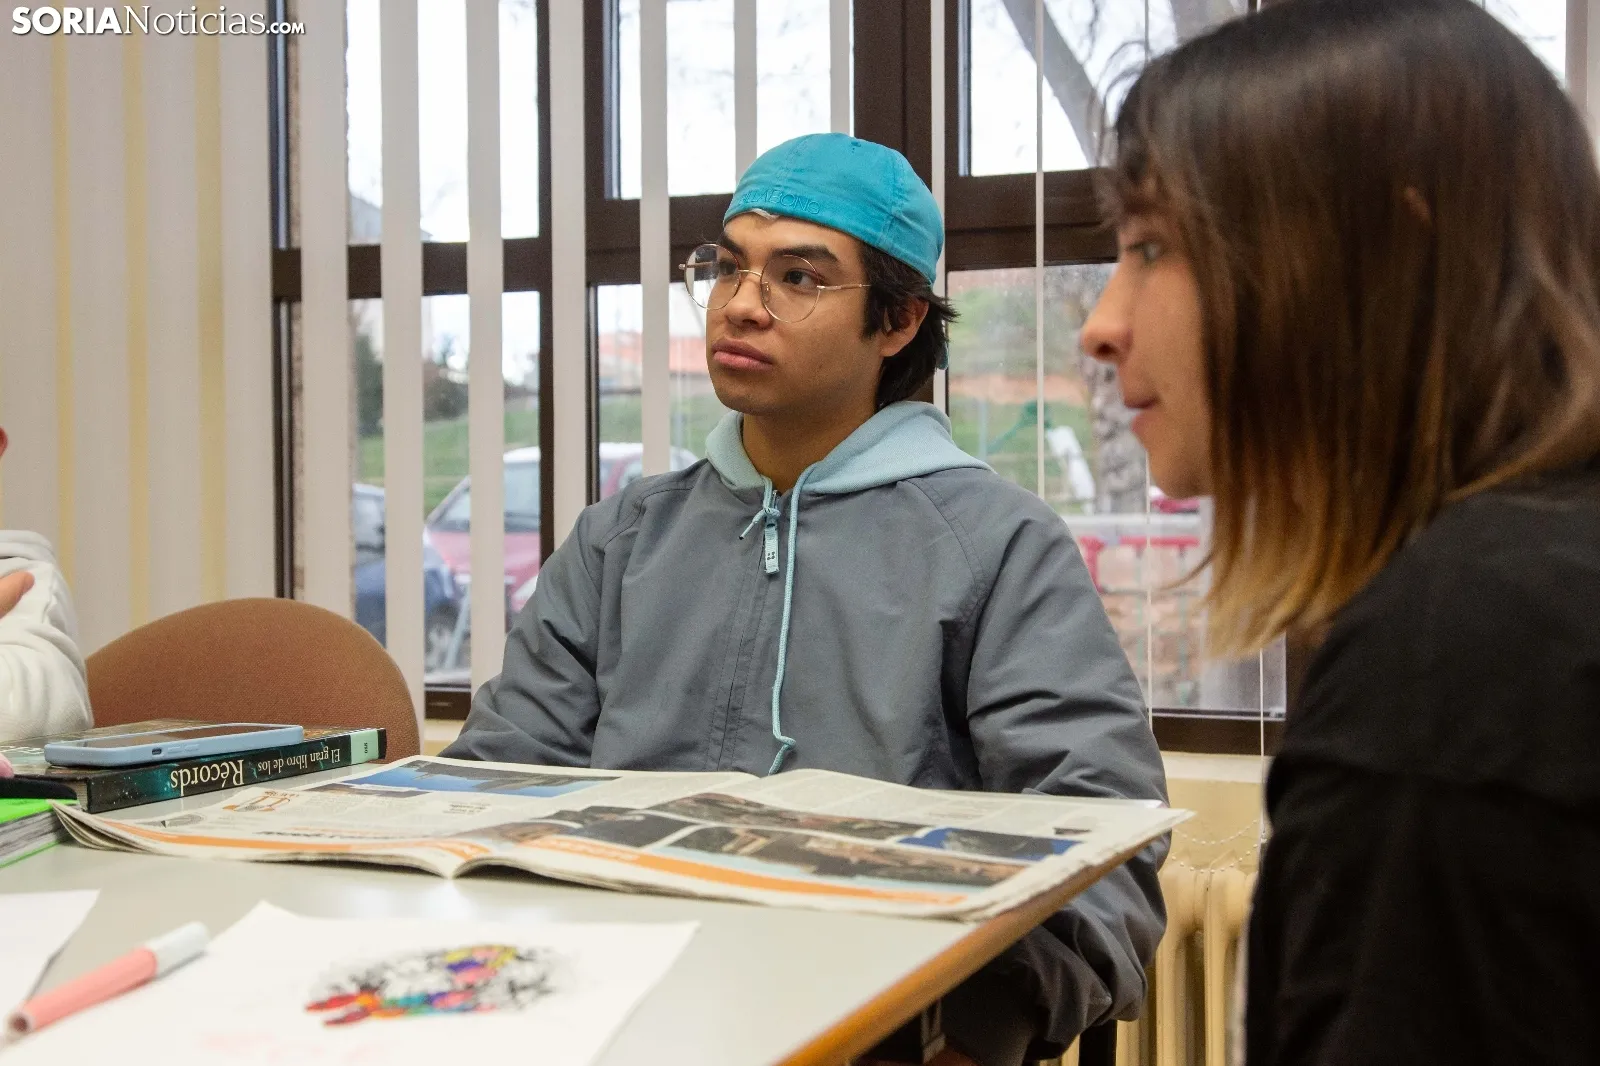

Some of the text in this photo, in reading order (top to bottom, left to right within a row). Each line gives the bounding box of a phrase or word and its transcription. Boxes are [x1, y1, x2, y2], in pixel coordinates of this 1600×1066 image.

[170, 746, 341, 797] El gran libro de los Récords
